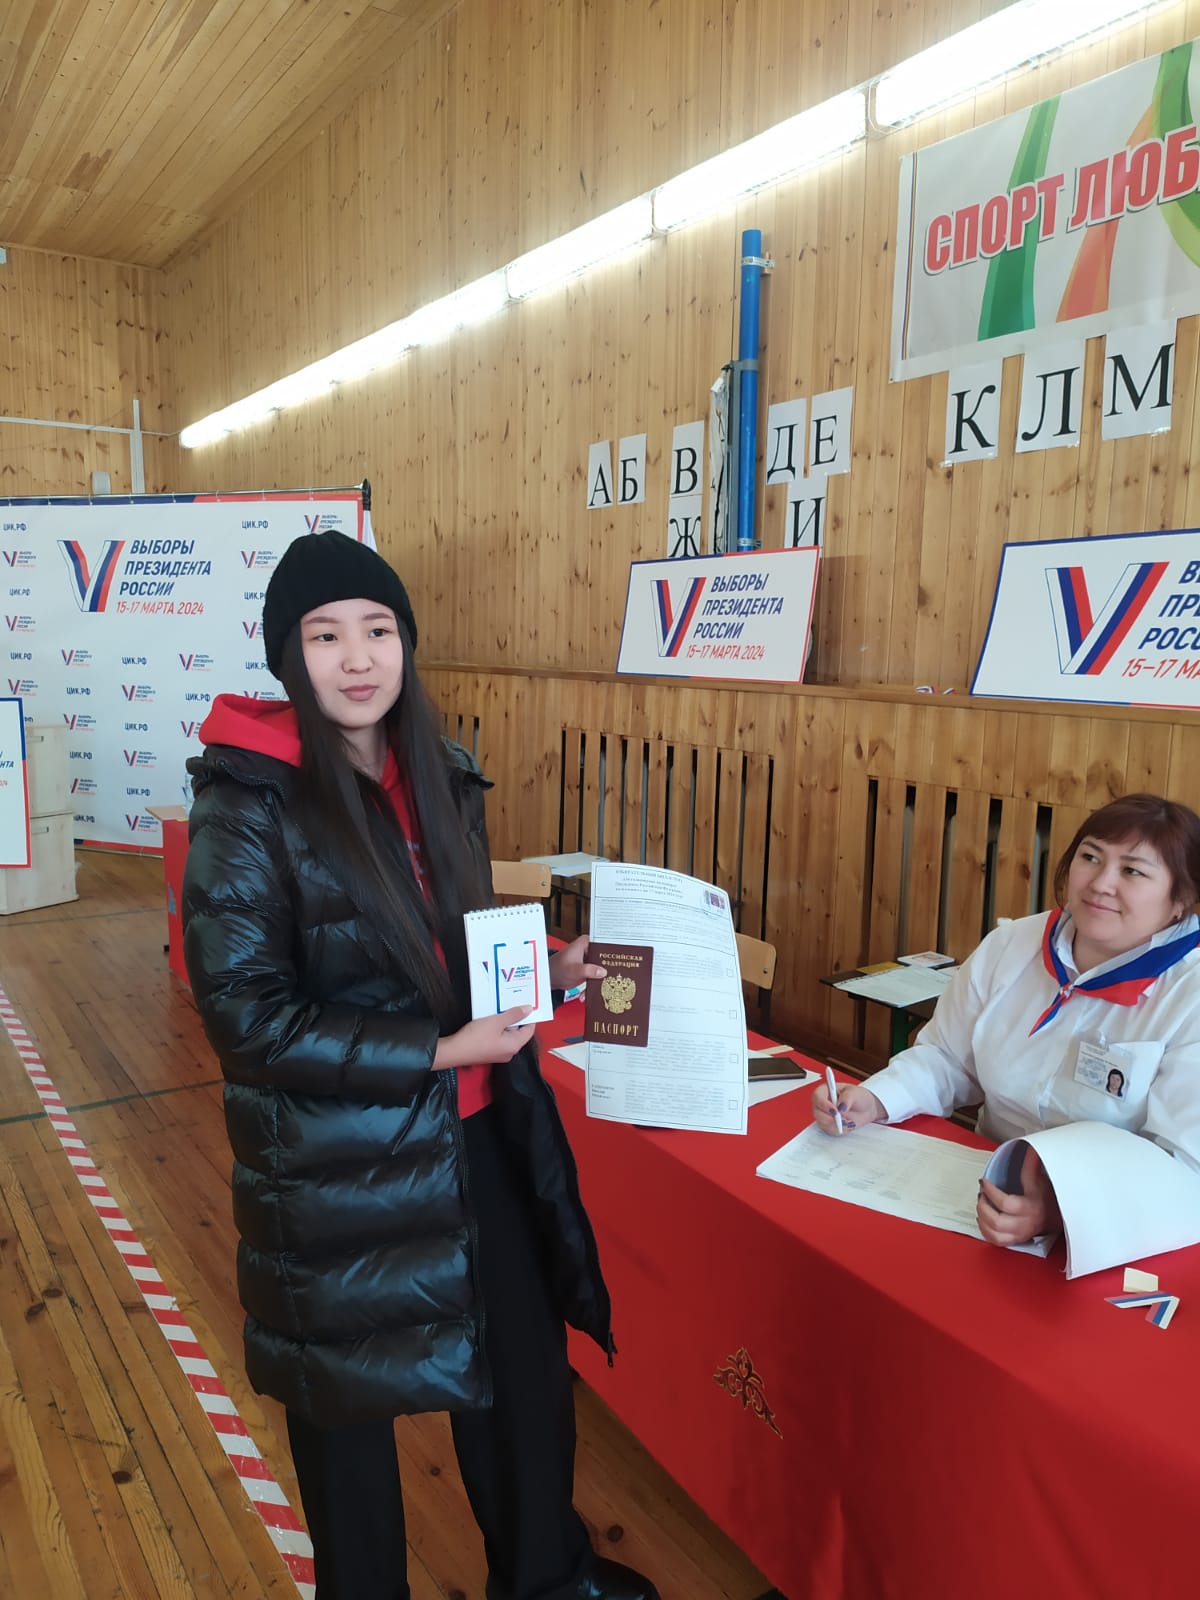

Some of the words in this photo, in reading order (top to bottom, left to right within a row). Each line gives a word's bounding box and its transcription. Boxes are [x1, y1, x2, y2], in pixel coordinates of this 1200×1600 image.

[925, 173, 1065, 273] СПОРТ
[1067, 126, 1200, 229] ЛЮБ
[949, 385, 997, 454] К
[1021, 367, 1080, 441] Л
[1104, 343, 1174, 417] М
[588, 463, 612, 506] А
[620, 457, 638, 502] Б
[672, 447, 698, 495] В
[767, 424, 798, 482] Д
[811, 415, 838, 466] Е
[241, 520, 269, 529] ЦИК.РФ
[669, 516, 701, 557] Ж
[790, 497, 825, 547] И
[130, 539, 195, 555] ВЫБОРЫ
[124, 560, 211, 578] ПРЕЗИДЕНТА
[1178, 560, 1200, 584] В
[119, 581, 175, 596] РОССИИ
[710, 573, 769, 592] ВЫБОРЫ
[244, 591, 266, 600] ЦИК.Р
[116, 601, 140, 614] 15-17
[141, 601, 174, 615] МАРТА
[177, 602, 205, 615] 2024
[702, 597, 784, 618] ПРЕЗИДЕНТА
[1158, 594, 1200, 617] ПР
[693, 622, 745, 639] РОССИИ
[710, 645, 741, 660] МАРТА
[741, 645, 765, 660] 2024
[122, 656, 147, 666] ЦИК.РФ
[66, 687, 91, 696] ЦИК.РФ
[185, 693, 211, 702] ЦИК.РФ
[126, 787, 151, 797] ЦИК.РФ
[600, 952, 643, 961] РОССИЙСКАЯ
[593, 1021, 639, 1037] ПАСПОРТ
